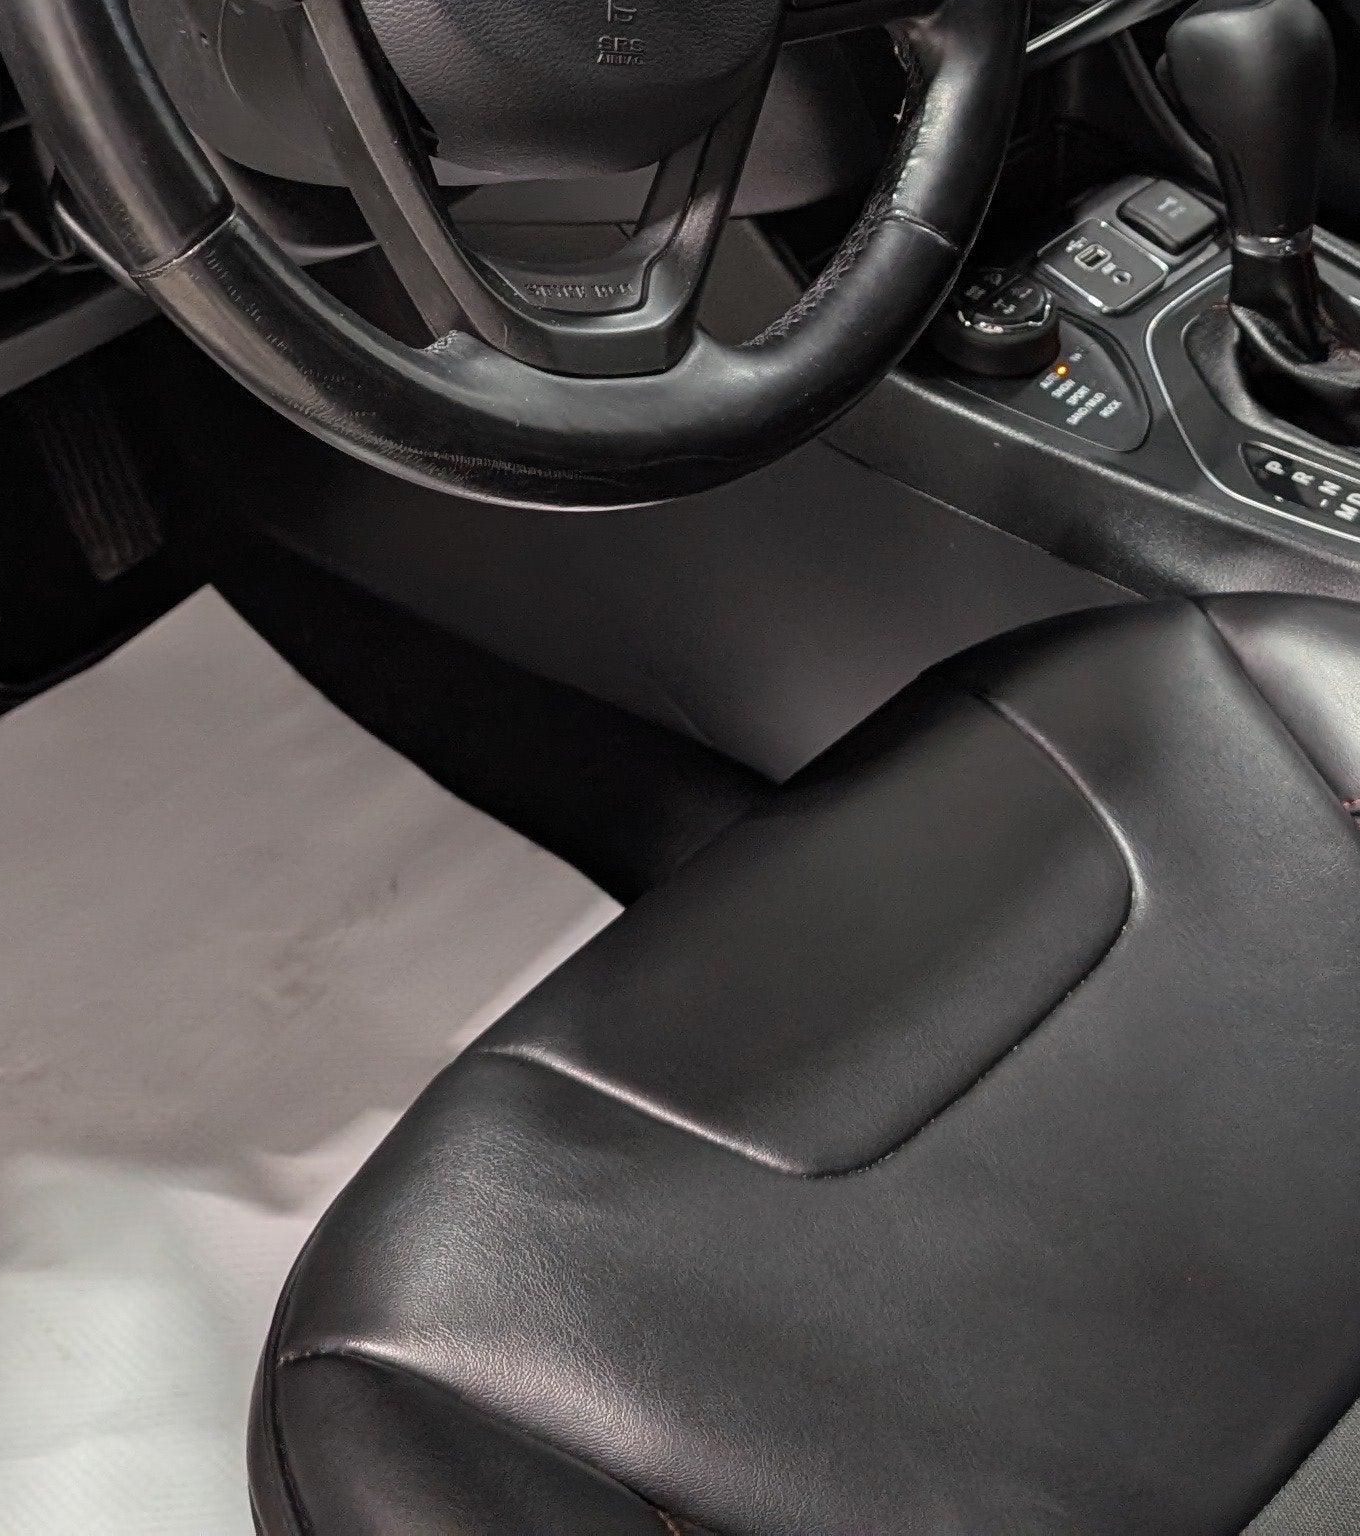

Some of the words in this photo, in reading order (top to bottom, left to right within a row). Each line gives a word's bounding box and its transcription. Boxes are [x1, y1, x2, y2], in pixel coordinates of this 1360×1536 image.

[598, 34, 644, 52] SRS
[1265, 460, 1285, 475] P
[1291, 471, 1315, 486] R
[1318, 480, 1342, 496] N
[1334, 503, 1360, 522] M
